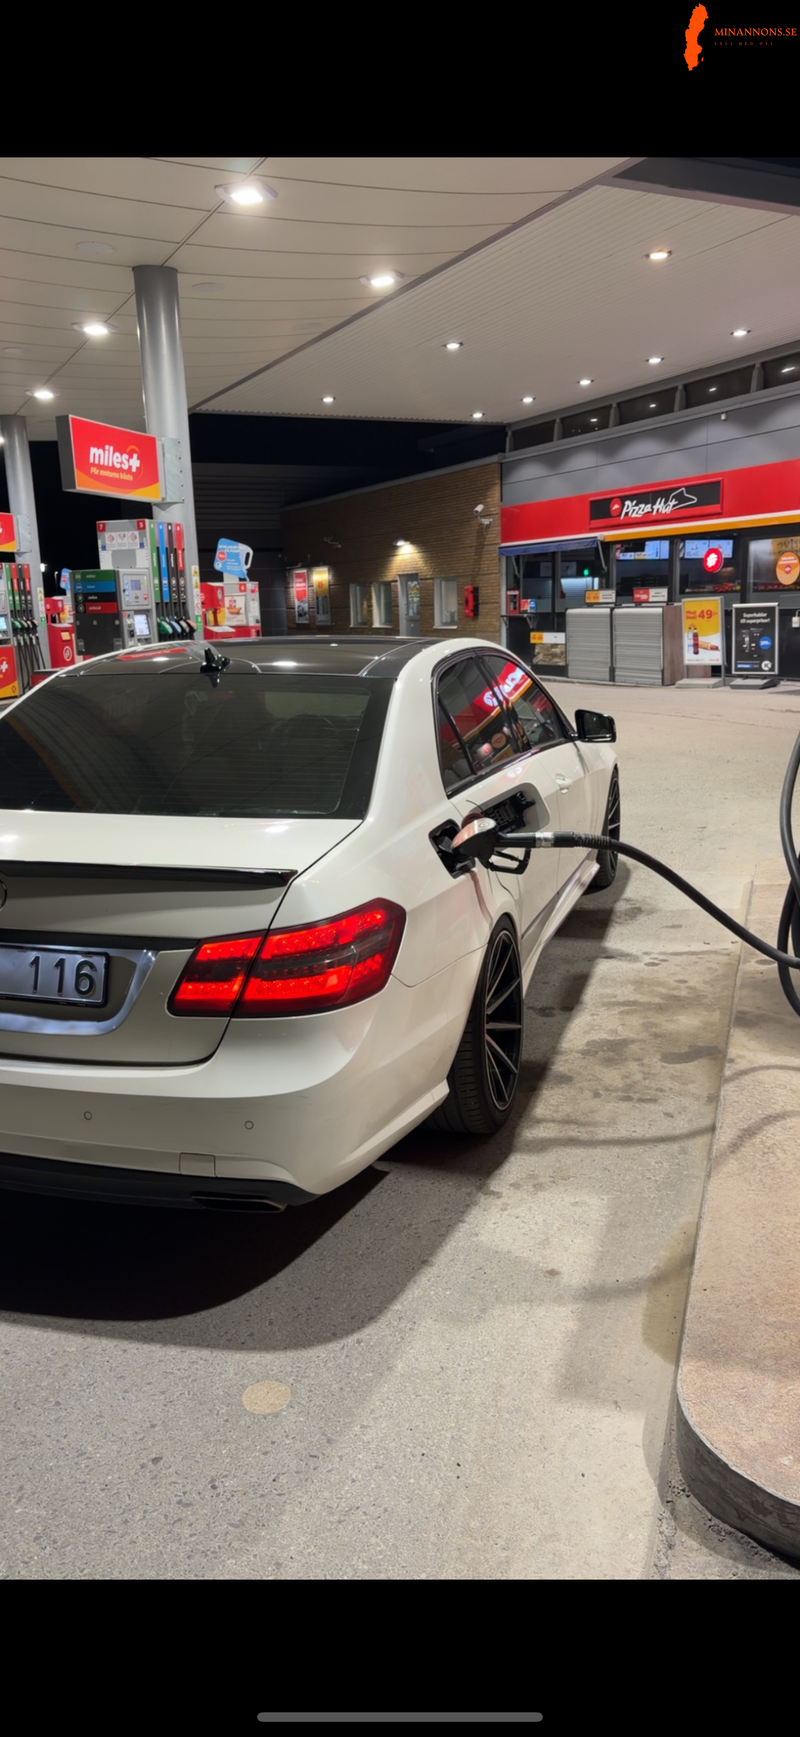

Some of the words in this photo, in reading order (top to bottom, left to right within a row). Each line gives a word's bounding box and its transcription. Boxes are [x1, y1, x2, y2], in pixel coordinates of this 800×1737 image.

[89, 444, 140, 473] miles+
[620, 499, 652, 521] Pizza
[652, 497, 679, 516] Hut
[29, 955, 98, 996] 116
